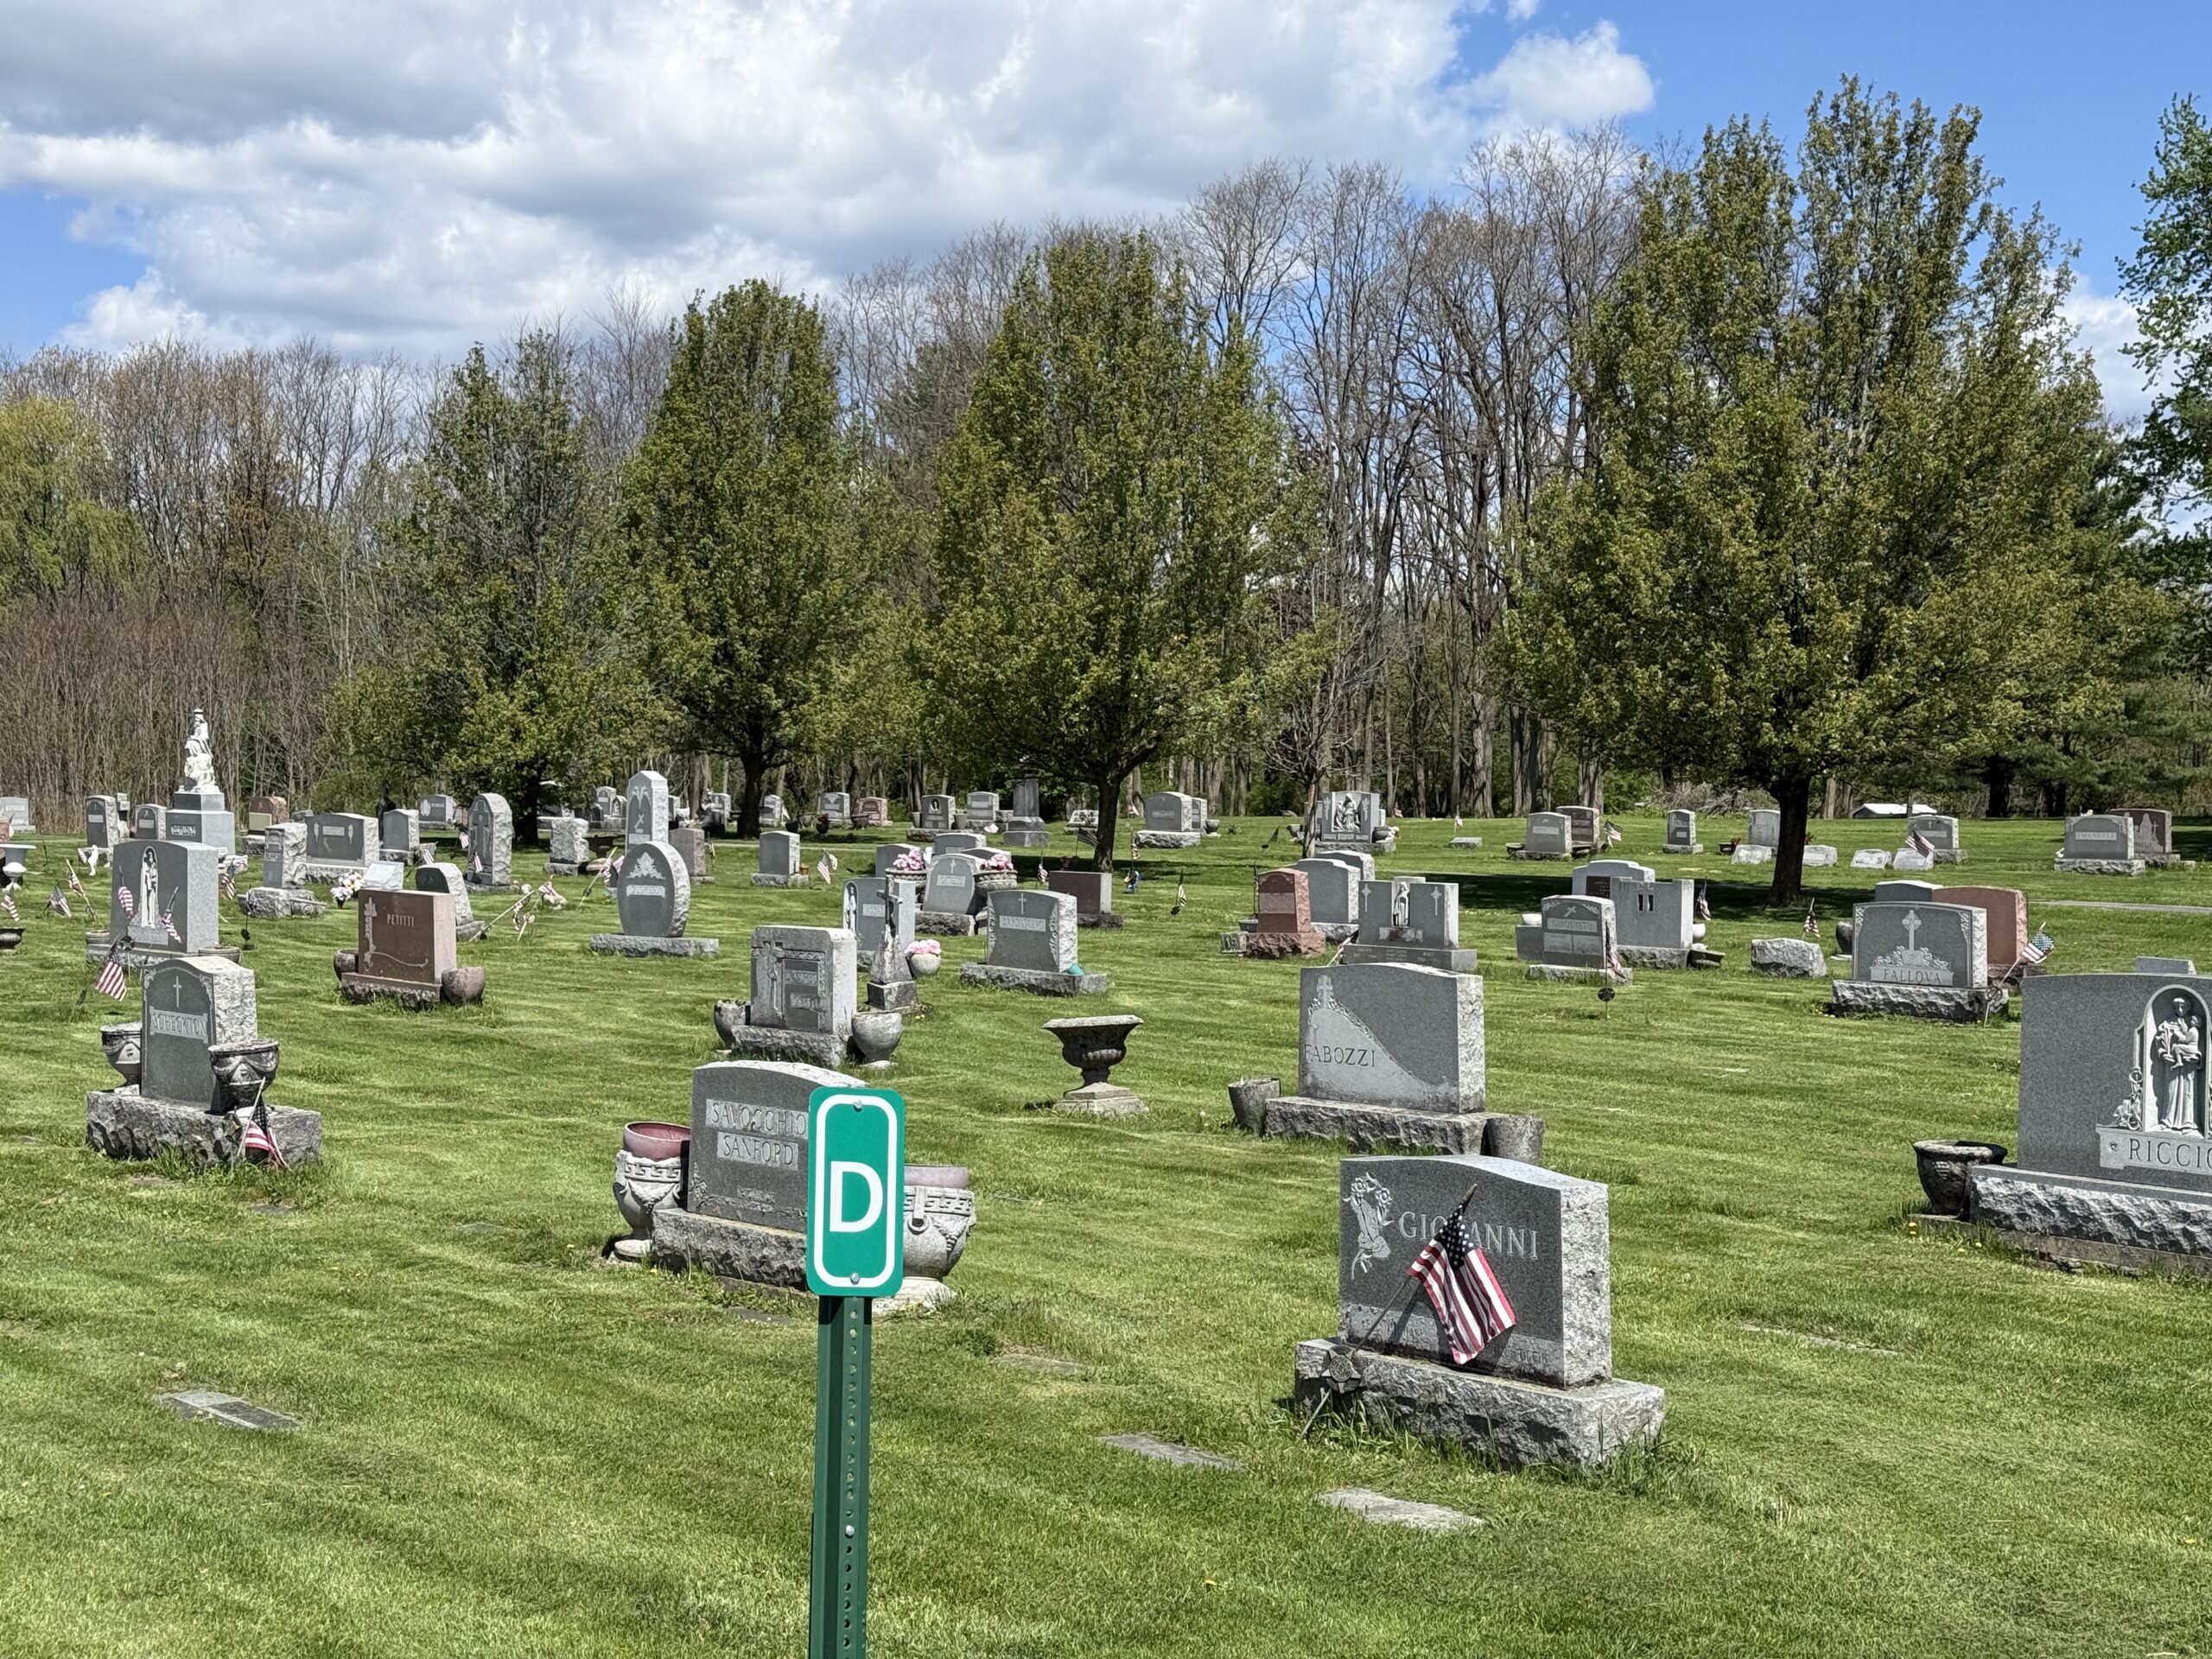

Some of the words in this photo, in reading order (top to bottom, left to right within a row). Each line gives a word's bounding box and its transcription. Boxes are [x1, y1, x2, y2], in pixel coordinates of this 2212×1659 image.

[387, 914, 415, 926] PETITTI
[1884, 969, 1942, 984] FALLOVA
[152, 1013, 207, 1037] SCHECKTON
[1303, 1044, 1375, 1067] FABOZZI
[711, 1103, 806, 1136] SAVOCCHIO
[723, 1135, 793, 1166] SANFORD
[830, 1160, 883, 1232] D
[1398, 1211, 1538, 1260] GIOANNI
